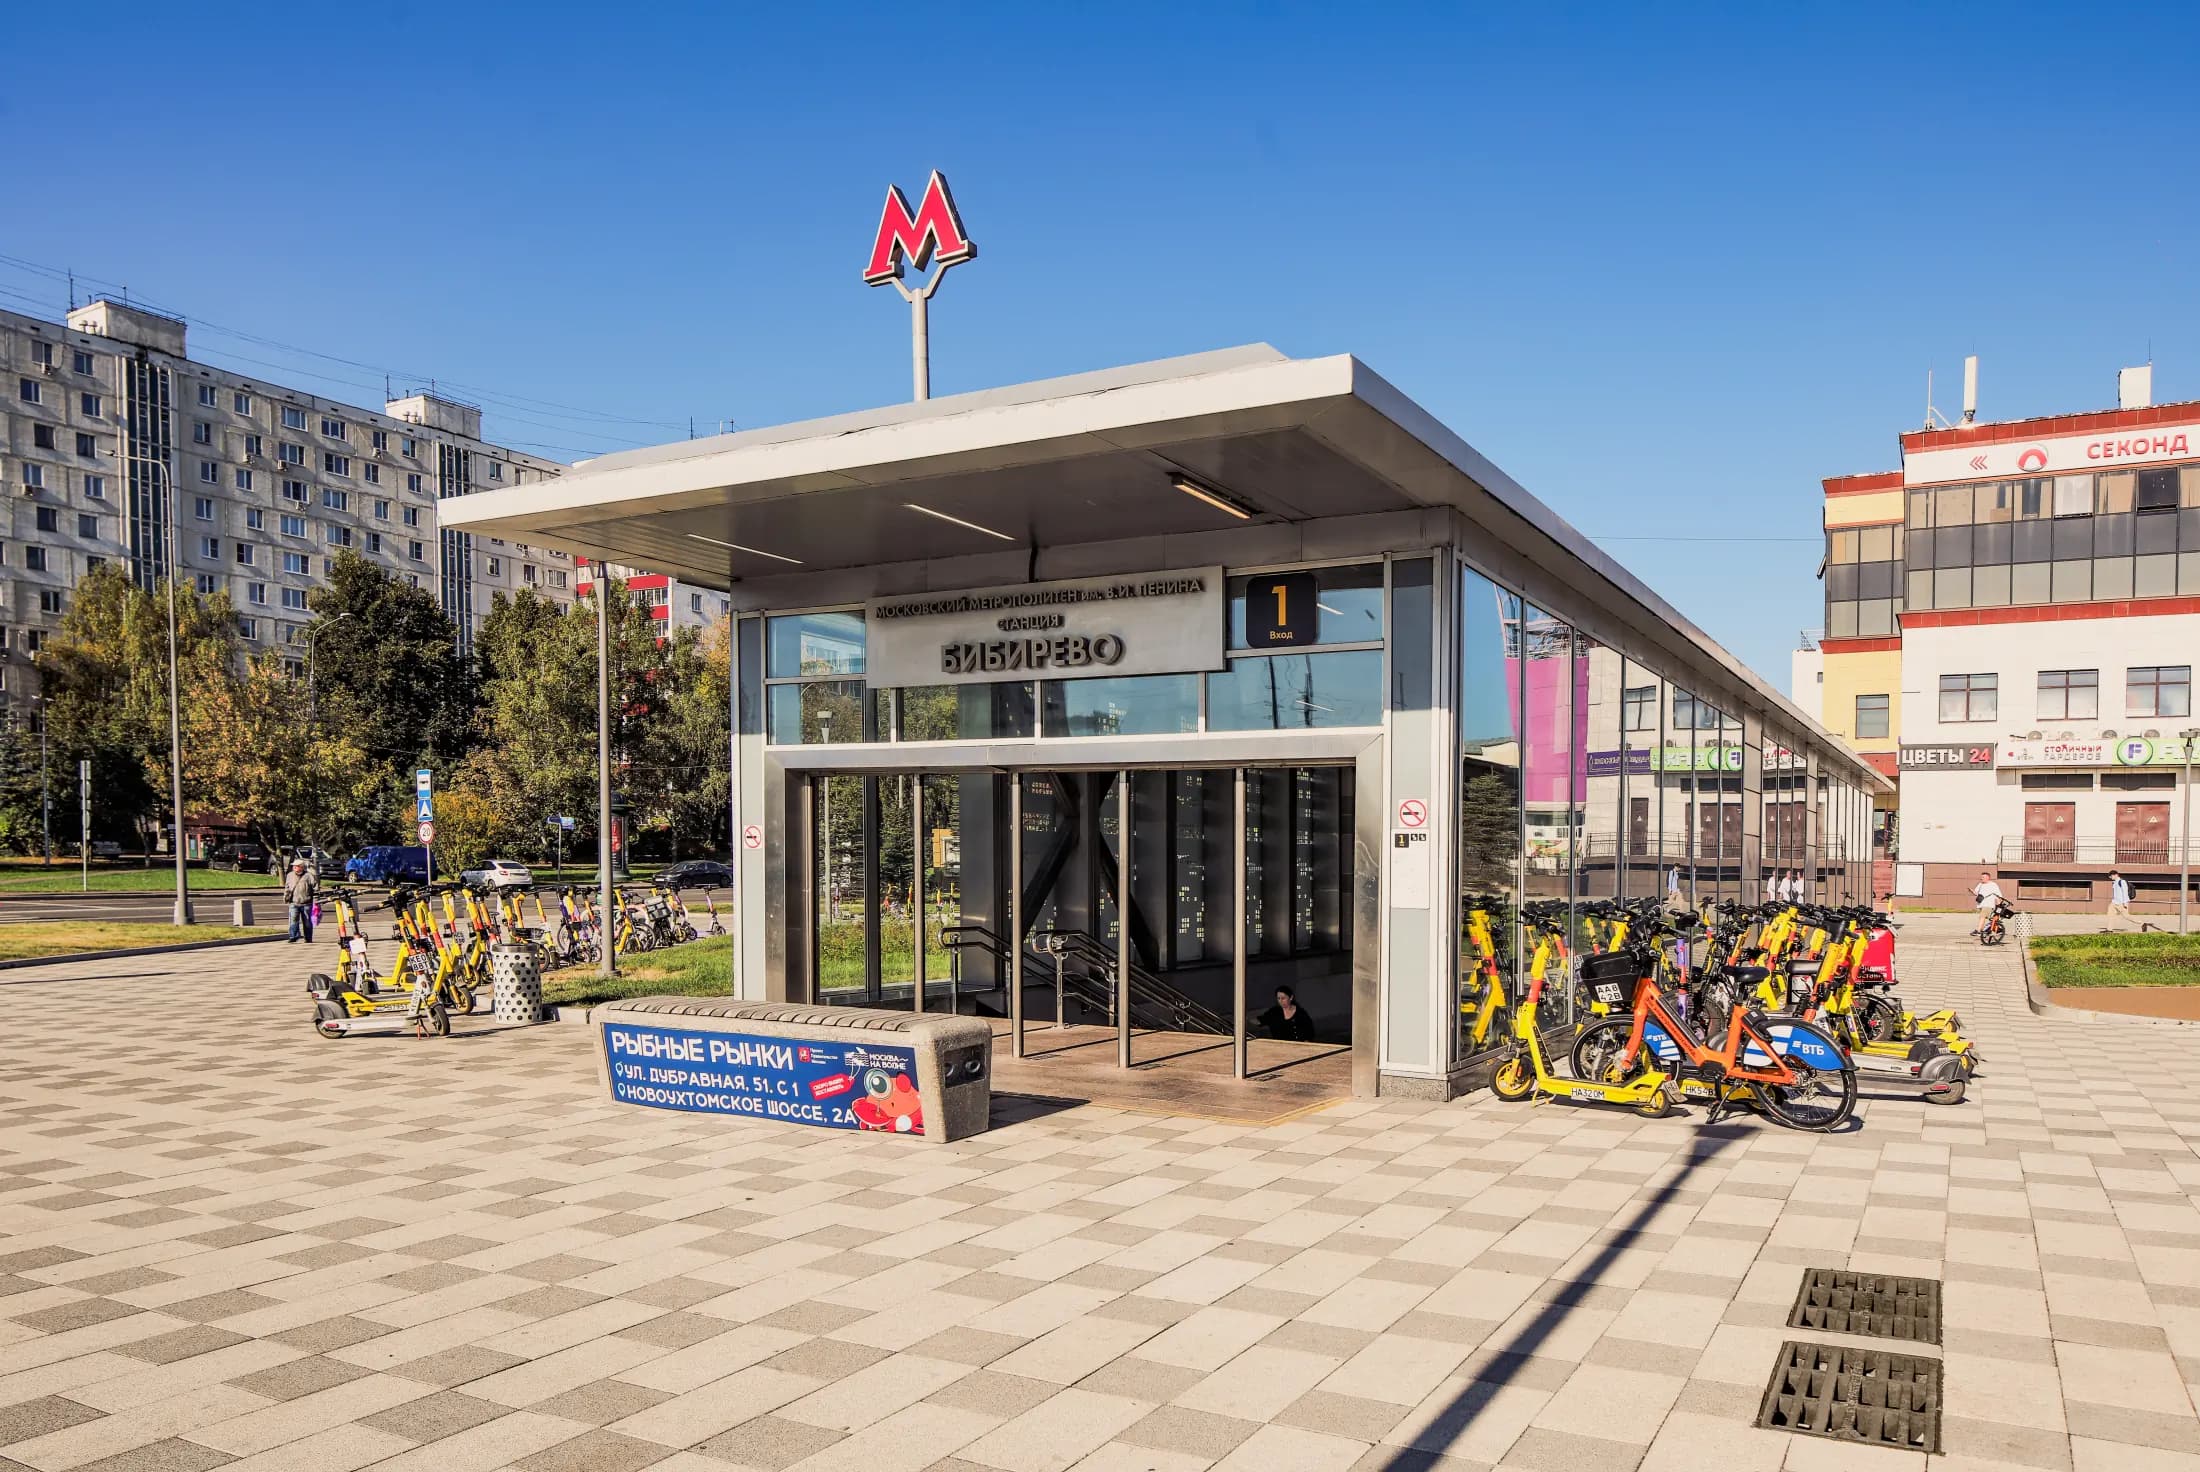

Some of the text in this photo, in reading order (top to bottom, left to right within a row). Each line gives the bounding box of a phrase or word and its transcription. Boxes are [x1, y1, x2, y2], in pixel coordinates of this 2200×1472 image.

[2087, 434, 2189, 459] СЕКОНД
[875, 598, 968, 619] МОСКОВСКИЙ
[968, 588, 1079, 610] МЕТРОПОЛИТЕН
[1138, 579, 1202, 597] ЛЕНИНА
[1271, 585, 1288, 626] 1
[998, 615, 1061, 630] СТАНЦИЯ
[1270, 631, 1293, 640] Вход
[941, 633, 1123, 673] БИБИРЕВО
[1902, 748, 1991, 767] ЦВЕТЫ 24
[2127, 743, 2143, 759] F
[422, 828, 432, 838] 20
[611, 1031, 705, 1062] РЫБНЫЕ
[709, 1040, 794, 1071] РЫНКИ
[869, 1053, 900, 1062] МОСКВА
[1801, 1043, 1825, 1056] ВТБ
[870, 1060, 906, 1070] НА ВОЛНЕ
[624, 1064, 799, 1097] УЛ. ДУБРАВНАЯ, 51. С 1
[627, 1085, 858, 1125] НОВОУХТОМСКОЕ ШОССЕ, 2А
